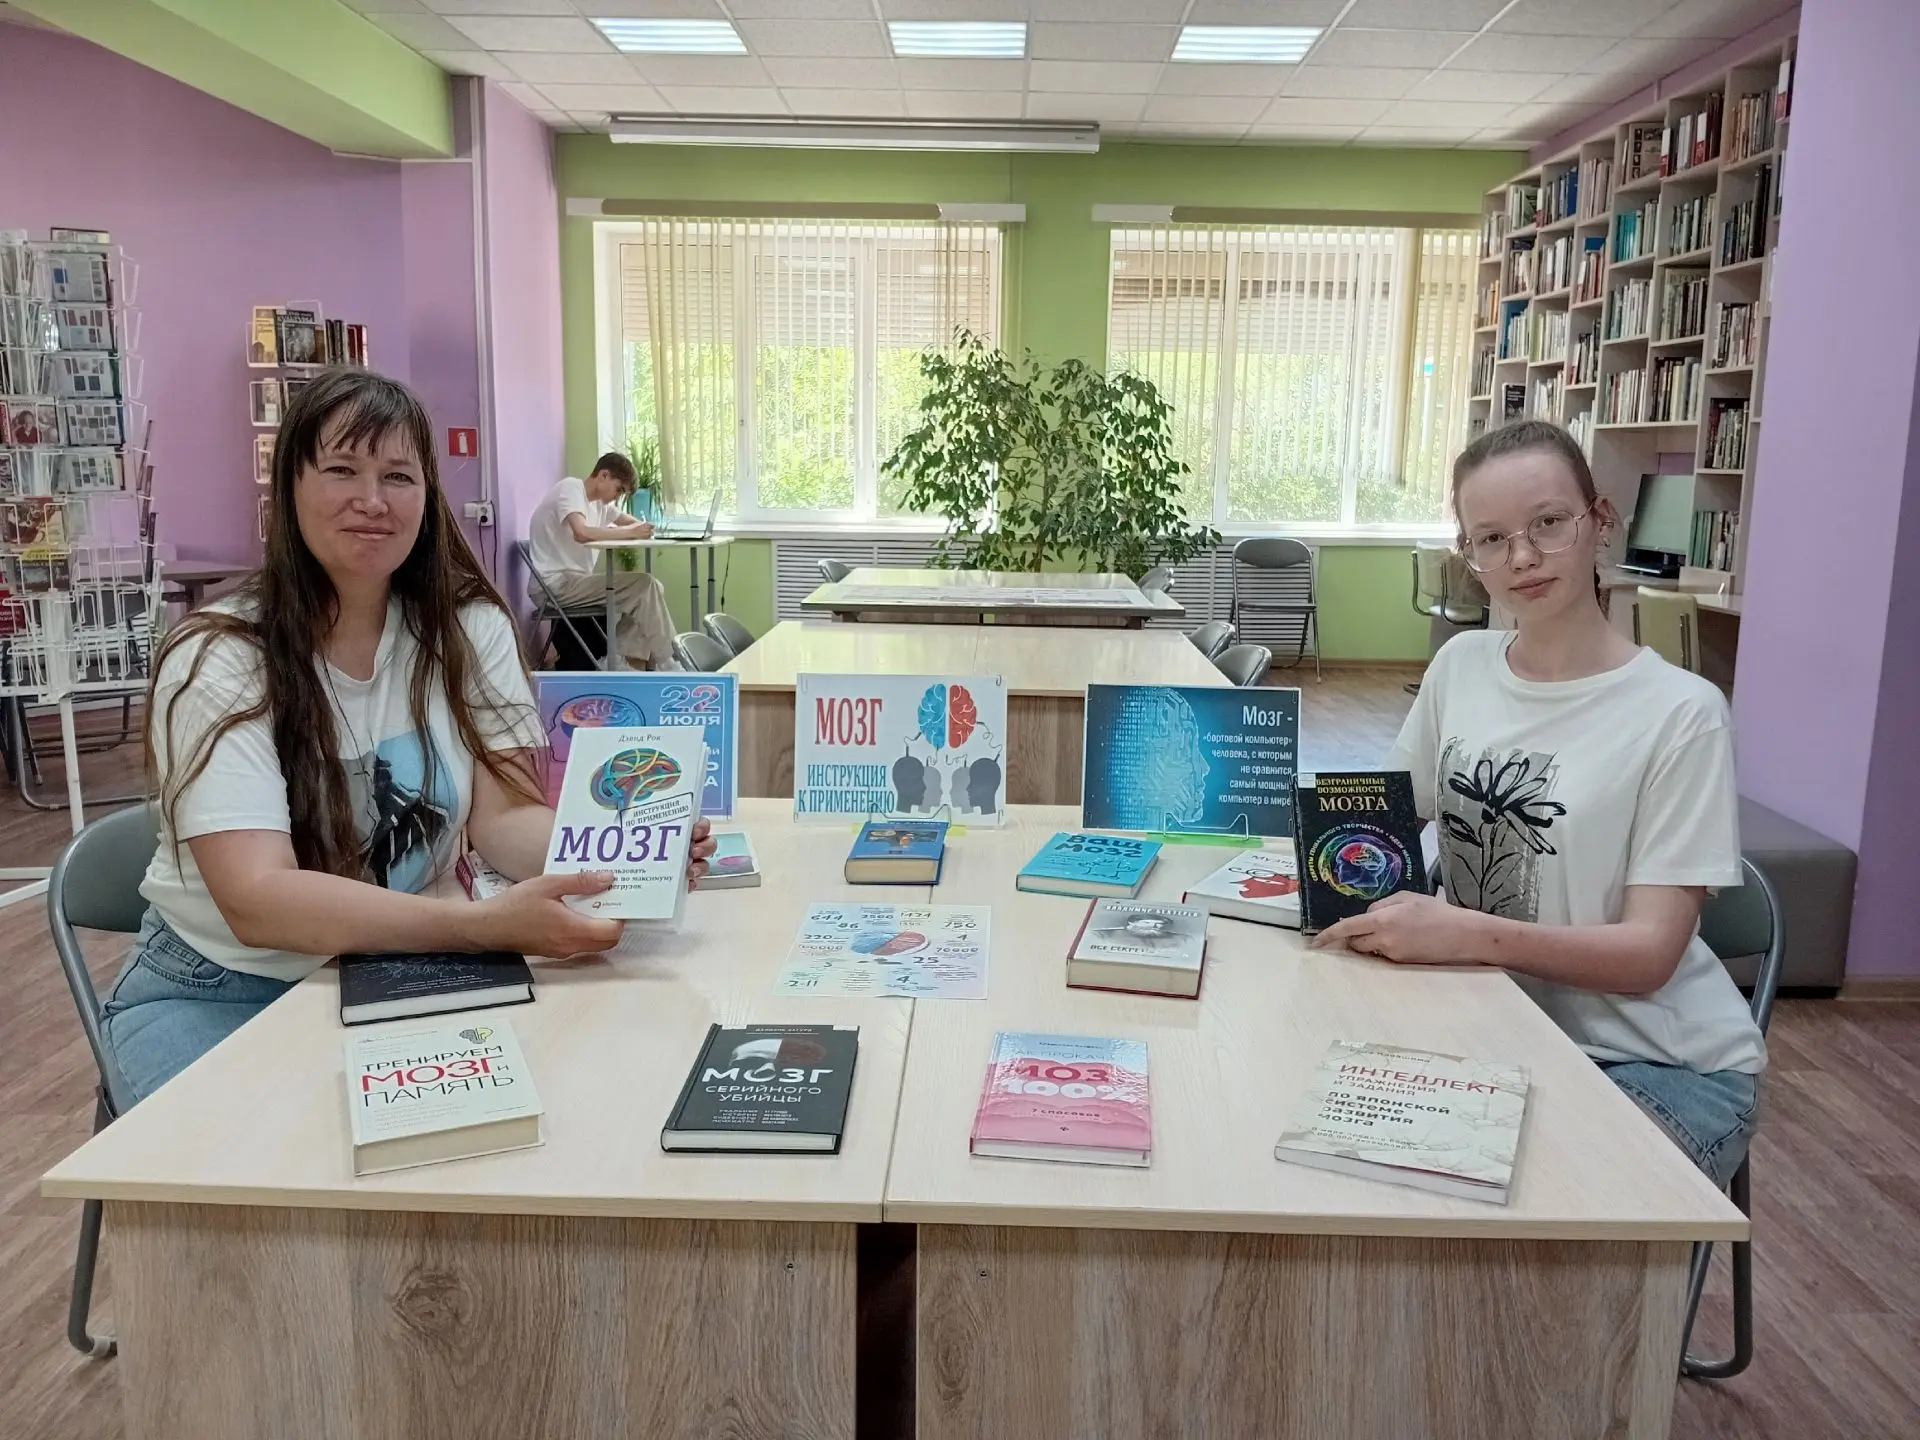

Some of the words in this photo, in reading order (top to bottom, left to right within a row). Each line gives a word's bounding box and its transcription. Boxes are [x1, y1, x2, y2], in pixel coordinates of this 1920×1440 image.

[660, 684, 721, 714] 22
[659, 714, 720, 725] ИЮЛЯ
[815, 697, 882, 746] МОЗГ
[1243, 705, 1283, 726] Мозг
[646, 734, 661, 742] Рок
[1203, 732, 1243, 744] «бортовой
[1244, 735, 1292, 747] компьютер»
[1212, 749, 1250, 759] человека,
[1251, 751, 1257, 759] с
[1258, 752, 1292, 762] которым
[807, 764, 887, 789] ИНСТРУКЦИЯ
[1240, 765, 1250, 773] не
[1252, 766, 1292, 776] сравнится
[1229, 779, 1256, 789] самый
[1316, 777, 1385, 786] БЕЗГРАНИЧНЫЕ
[1317, 785, 1385, 794] ВОЗМОЖНОСТИ
[632, 799, 680, 818] ИНСТРУКЦИЯ
[798, 789, 806, 813] К
[808, 789, 895, 814] ПРИМЕНЕНИЮ
[1219, 794, 1262, 806] компьютер
[1264, 796, 1269, 804] в
[1270, 797, 1291, 806] мире
[1318, 795, 1390, 812] МОЗГА
[625, 819, 637, 828] ПО
[637, 804, 689, 824] ПРИМЕНЕНИЮ
[1342, 823, 1384, 834] ТВОРЧЕСТВА
[554, 825, 682, 862] МОЗГ
[913, 956, 940, 964] 25
[361, 1045, 503, 1073] ТРЕНИРУЕМ
[361, 1054, 504, 1093] МОЗГ
[701, 1067, 834, 1084] МОЗГ
[1340, 1064, 1499, 1095] ИНТЕЛЛЕКТ
[364, 1074, 514, 1107] ПАМЯТЬ
[705, 1084, 822, 1095] СЕРИЙНОГО
[1338, 1074, 1437, 1094] УПРАЖНЕНИЯ
[1347, 1081, 1415, 1096] ЗАДАНИЯ
[719, 1093, 801, 1103] УБИЙЦЫ
[1356, 1093, 1450, 1115] японской
[1325, 1099, 1405, 1116] системе
